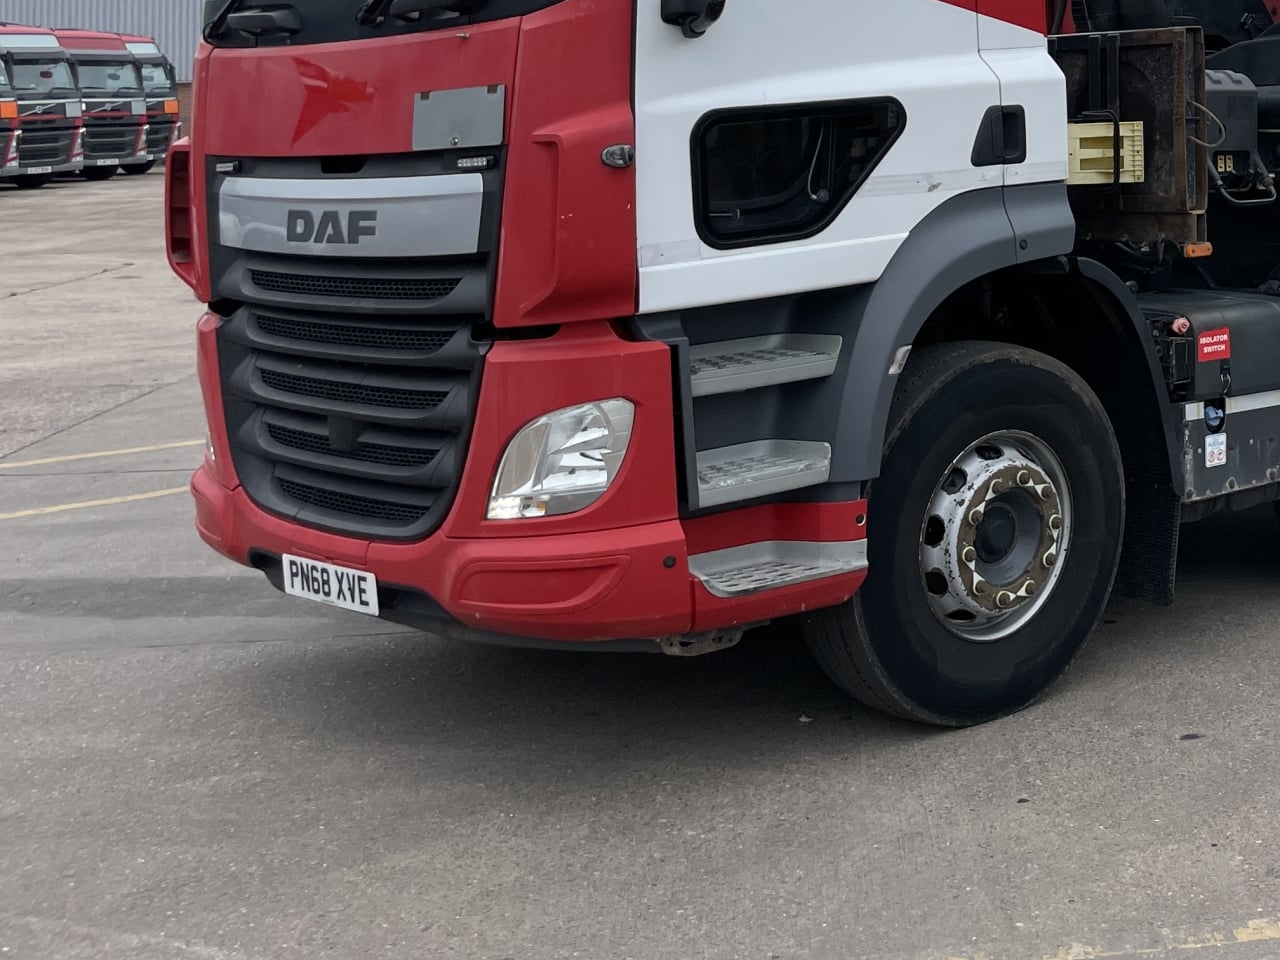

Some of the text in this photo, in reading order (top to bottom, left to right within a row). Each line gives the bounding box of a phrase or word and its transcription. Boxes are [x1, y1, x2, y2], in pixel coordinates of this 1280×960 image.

[286, 209, 378, 245] DAF
[1199, 334, 1228, 344] ISOLATOR
[1203, 344, 1226, 354] SWITCH
[289, 559, 370, 607] PN68 XVE
